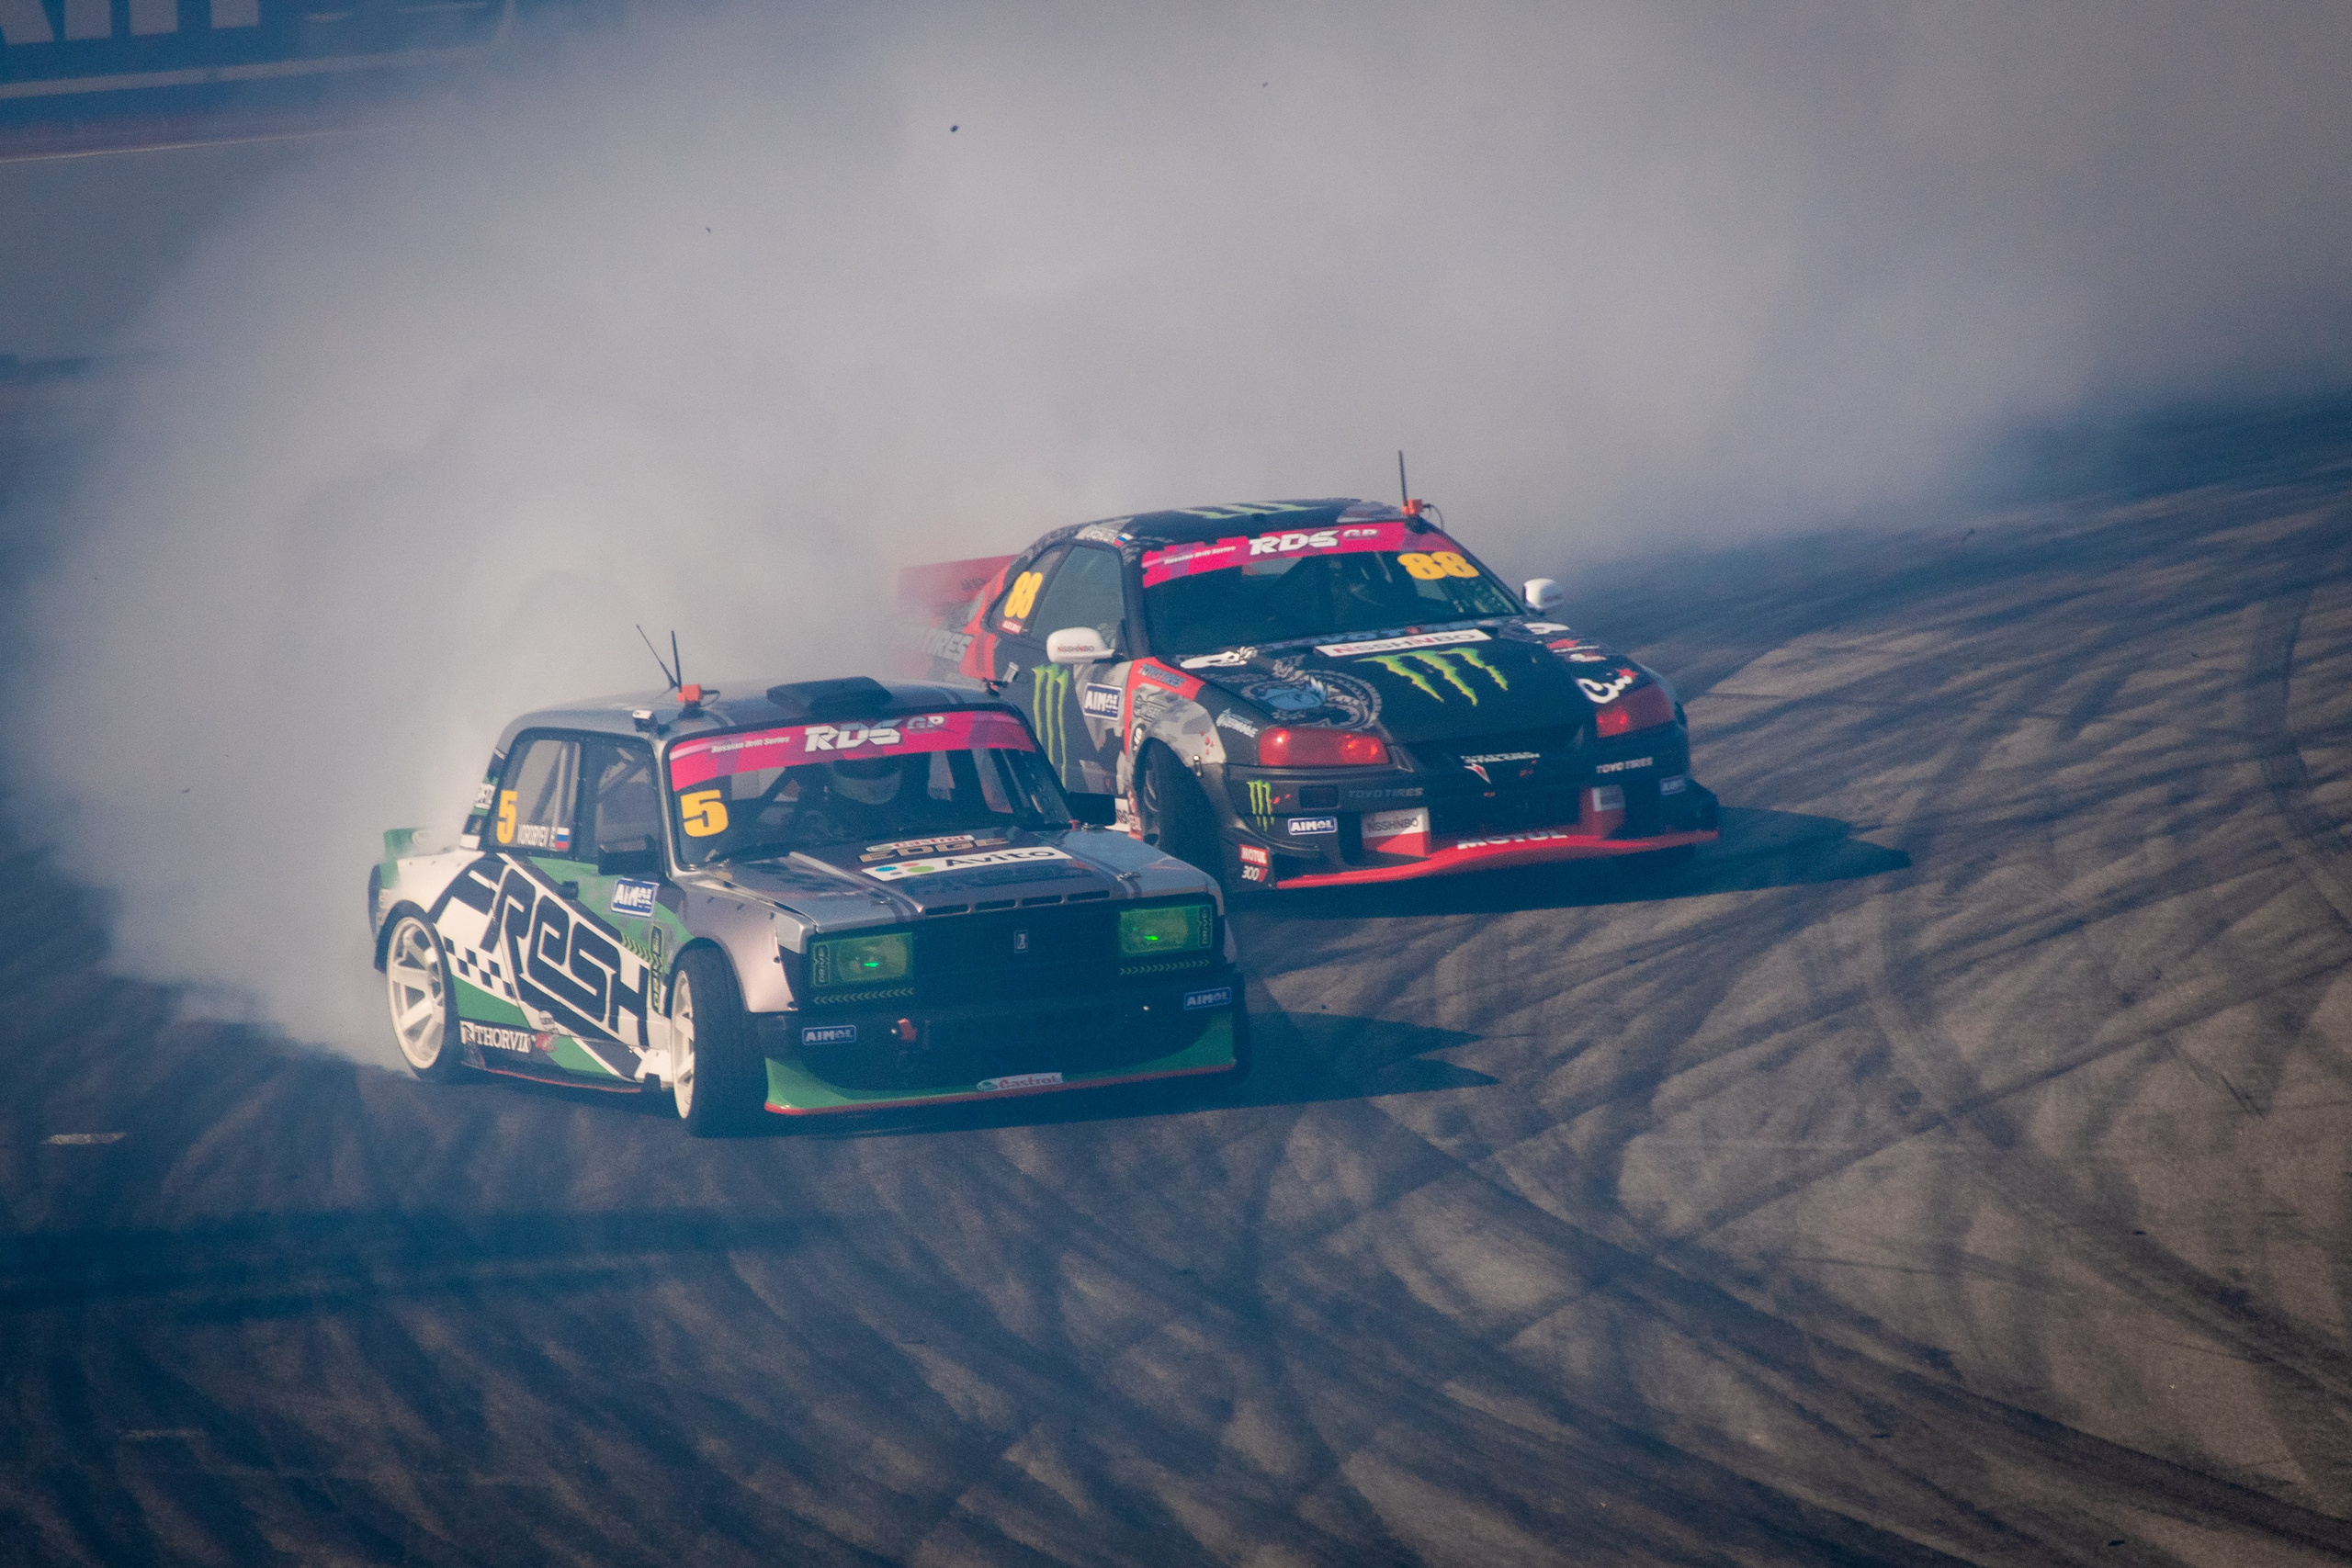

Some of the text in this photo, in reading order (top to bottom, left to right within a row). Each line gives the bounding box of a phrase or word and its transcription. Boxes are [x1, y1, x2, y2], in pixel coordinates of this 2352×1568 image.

[1250, 530, 1339, 556] RDS
[1396, 551, 1480, 581] 88
[1003, 570, 1043, 619] 88
[805, 718, 901, 753] RDS
[907, 716, 945, 730] GP
[497, 790, 518, 844] 5
[680, 789, 729, 838] 5
[1290, 819, 1334, 833] AIMOL
[859, 837, 1012, 863] EDGE
[944, 850, 1056, 868] Avito
[1186, 991, 1229, 1007] AIMOL
[805, 1030, 854, 1042] AIMOL
[998, 1075, 1057, 1089] Castrol
